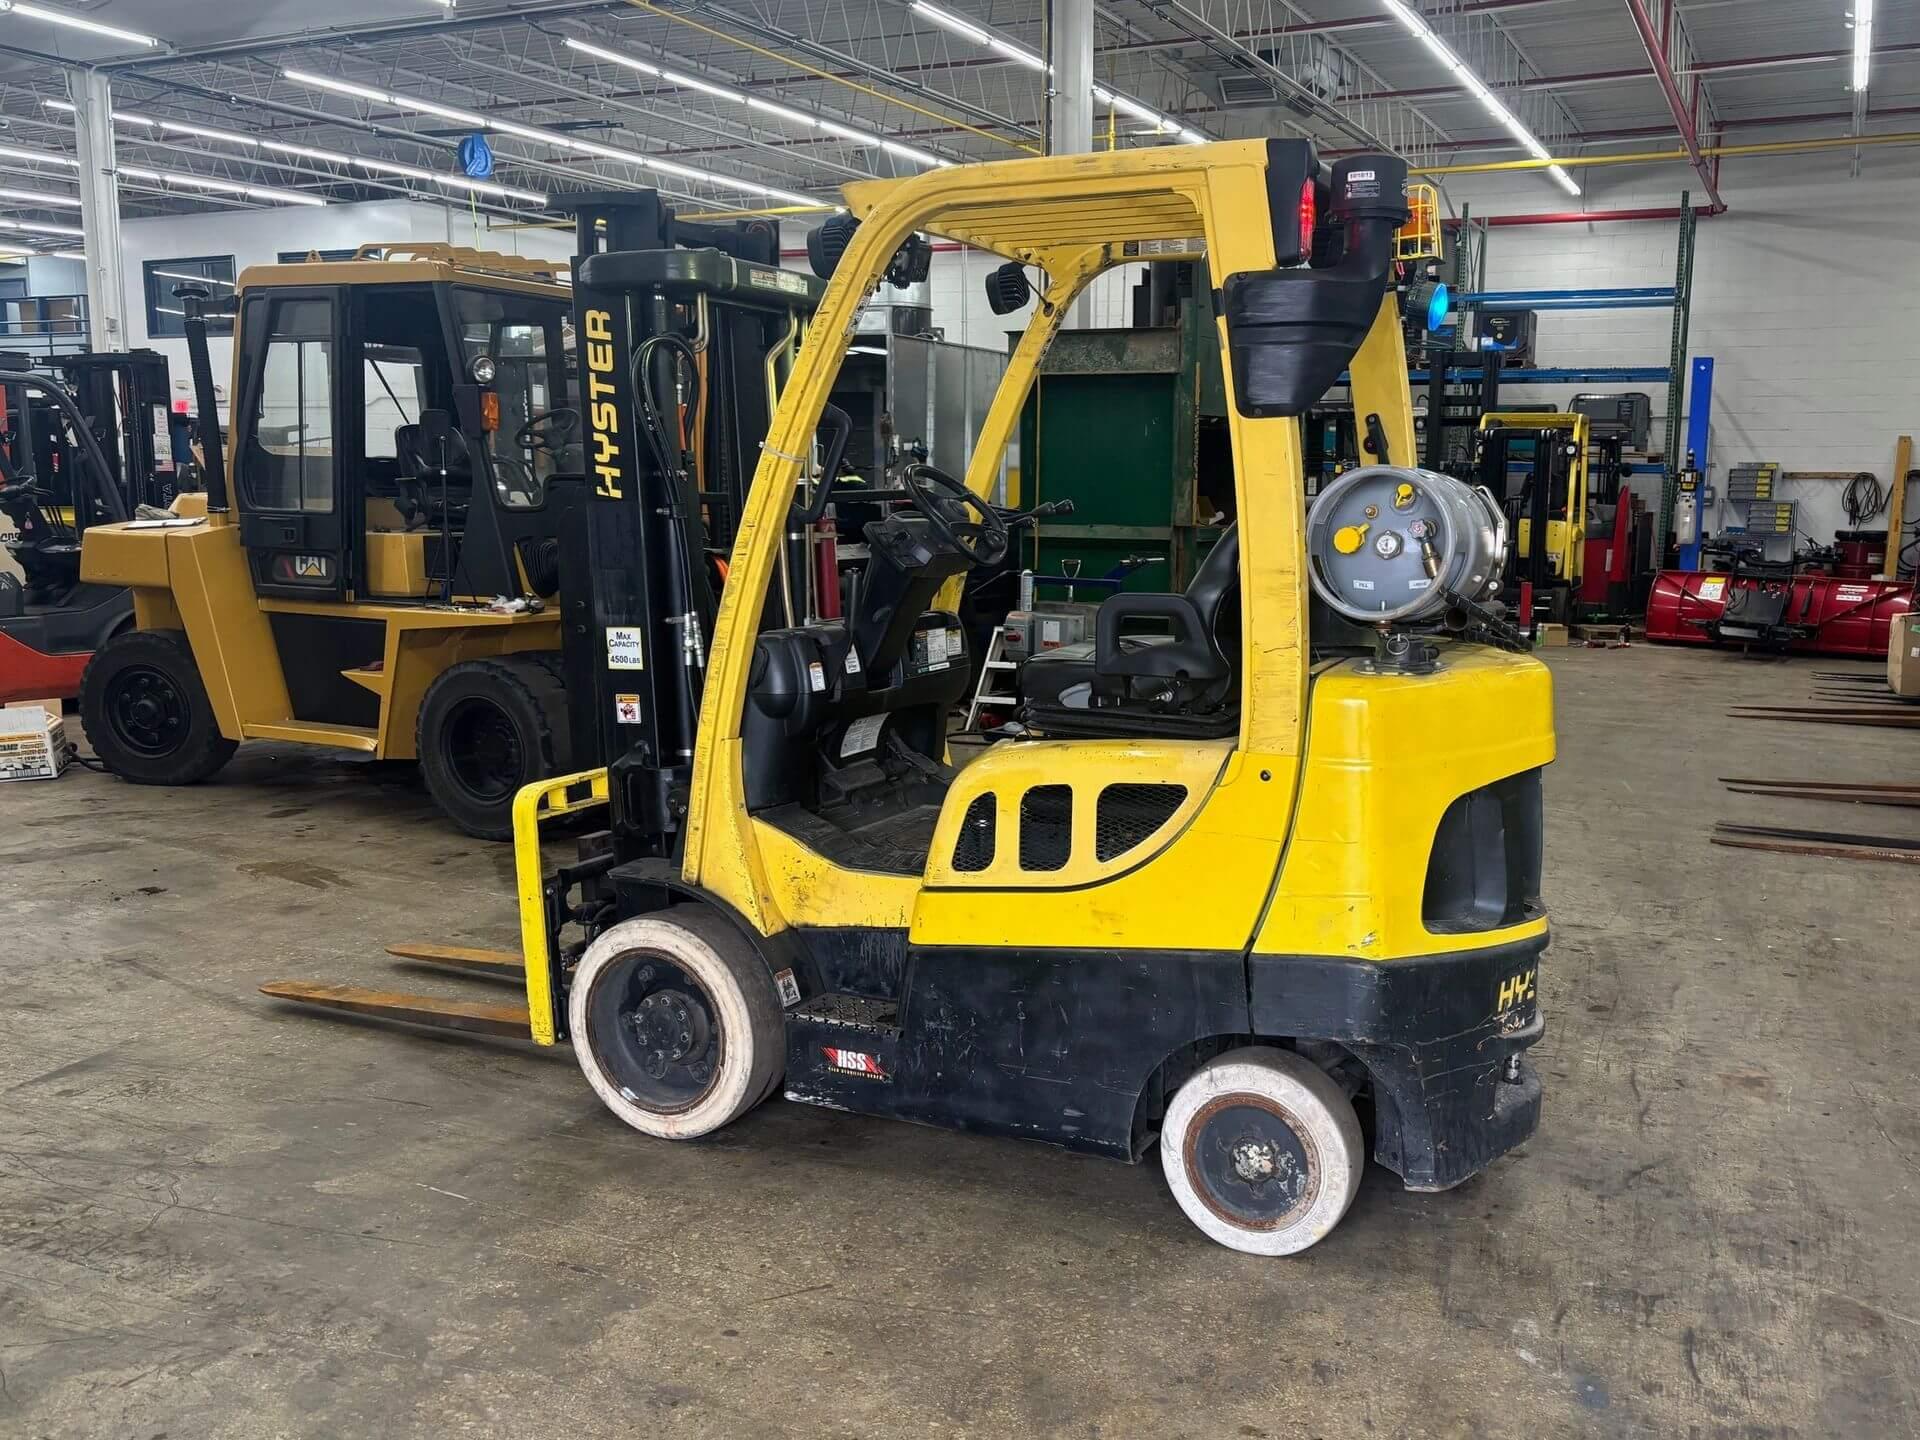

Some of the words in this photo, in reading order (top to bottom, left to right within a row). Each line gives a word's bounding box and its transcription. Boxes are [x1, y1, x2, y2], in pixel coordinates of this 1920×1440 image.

[585, 309, 623, 499] HYSTER
[295, 556, 327, 577] CAT
[610, 655, 629, 664] 4500
[837, 1049, 867, 1071] HSS
